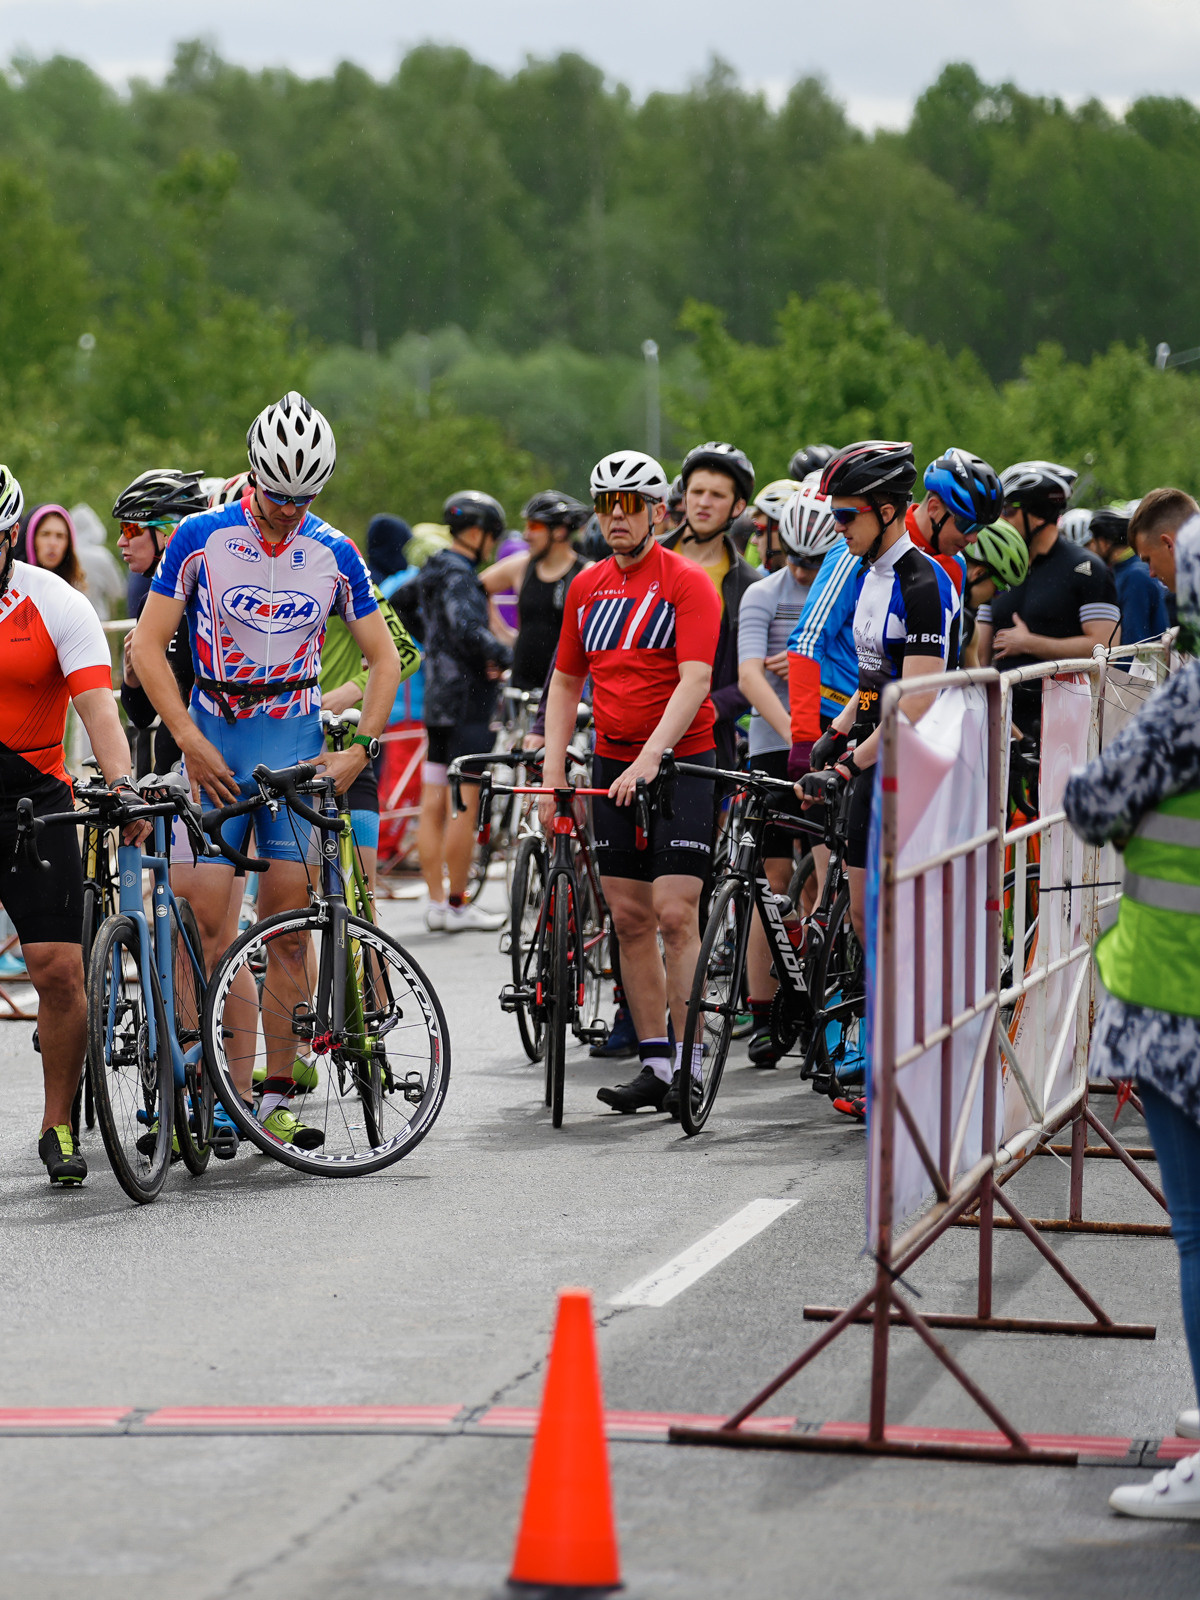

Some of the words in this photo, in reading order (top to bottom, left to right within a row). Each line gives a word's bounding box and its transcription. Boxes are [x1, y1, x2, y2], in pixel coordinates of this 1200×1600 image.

[228, 542, 260, 559] ITERA
[230, 593, 315, 619] ITERA
[921, 633, 945, 645] BCN
[266, 839, 297, 847] ITERA
[755, 877, 808, 992] MERIDA
[431, 1063, 439, 1089] AERO
[283, 1124, 412, 1161] EASTON
